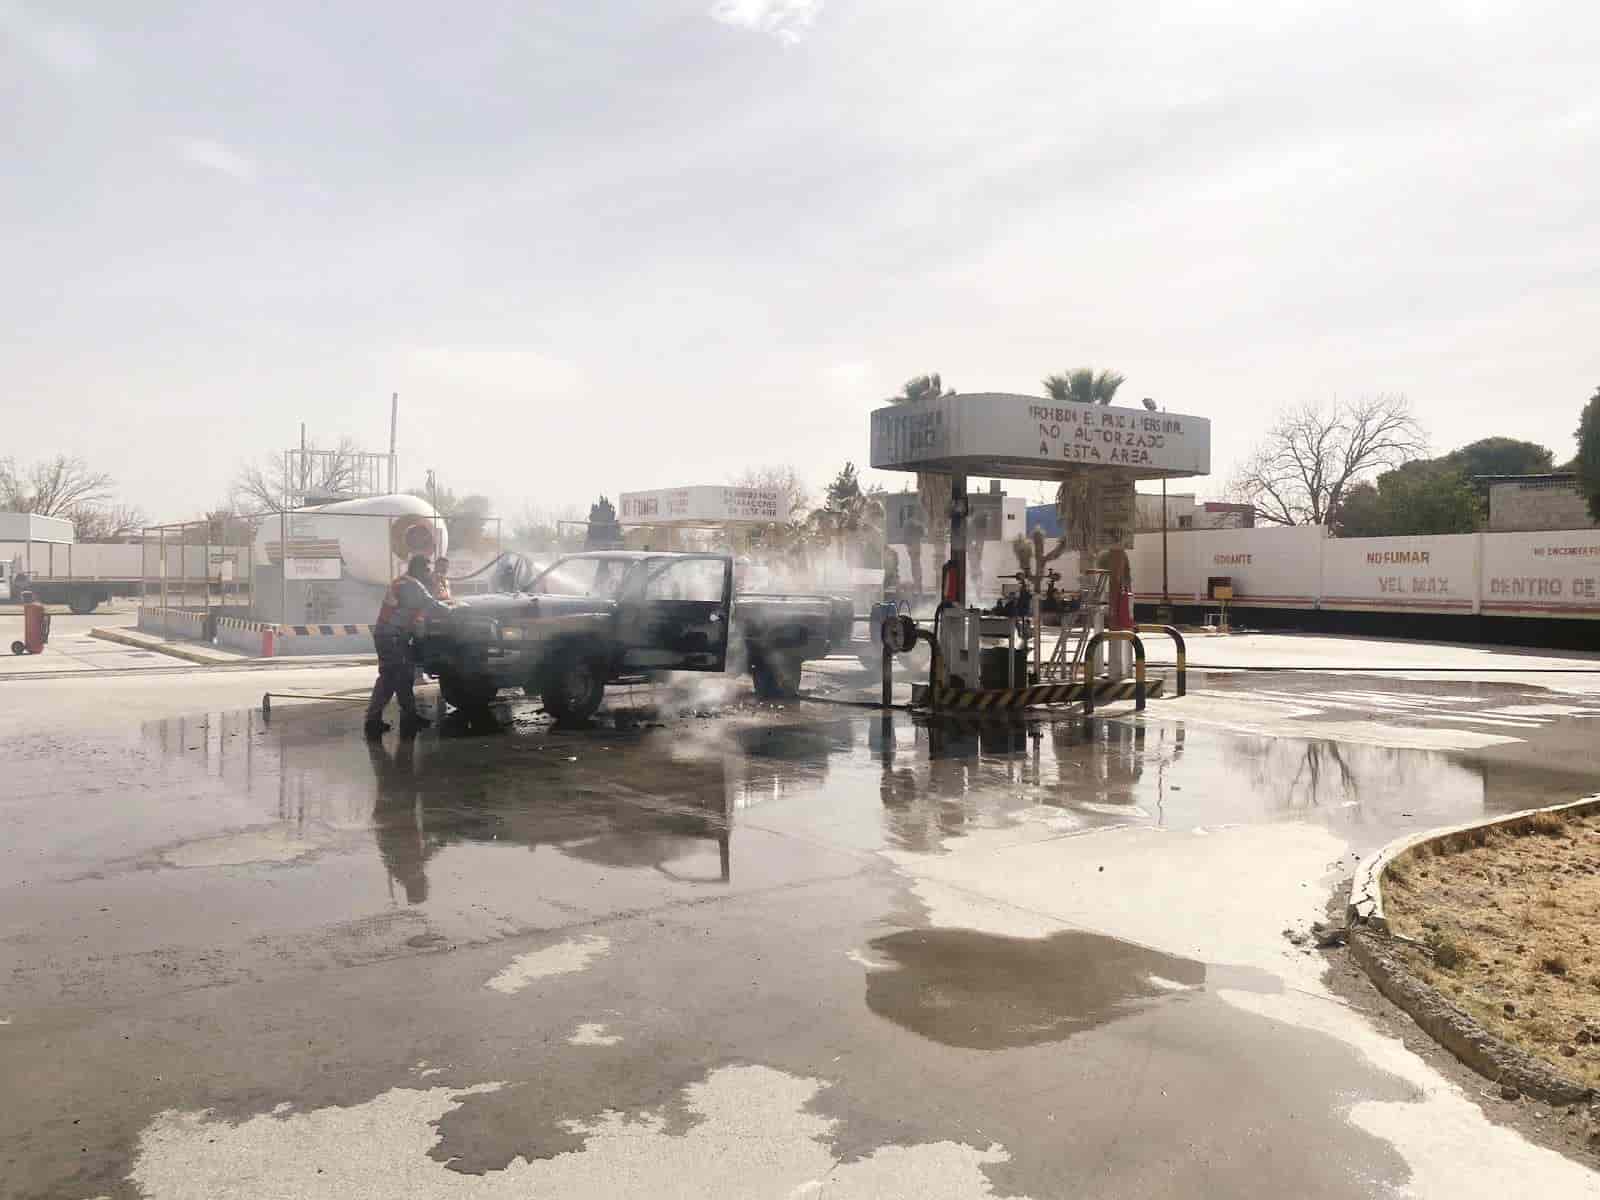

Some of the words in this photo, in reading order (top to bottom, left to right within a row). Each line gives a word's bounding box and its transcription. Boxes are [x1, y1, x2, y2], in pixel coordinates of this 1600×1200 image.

[1040, 424, 1060, 439] NO
[1040, 441, 1048, 456] A
[1064, 443, 1100, 459] ESTA
[1367, 552, 1381, 564] NO
[1383, 552, 1430, 564] FUMAR
[1491, 578, 1561, 596] DENTRO
